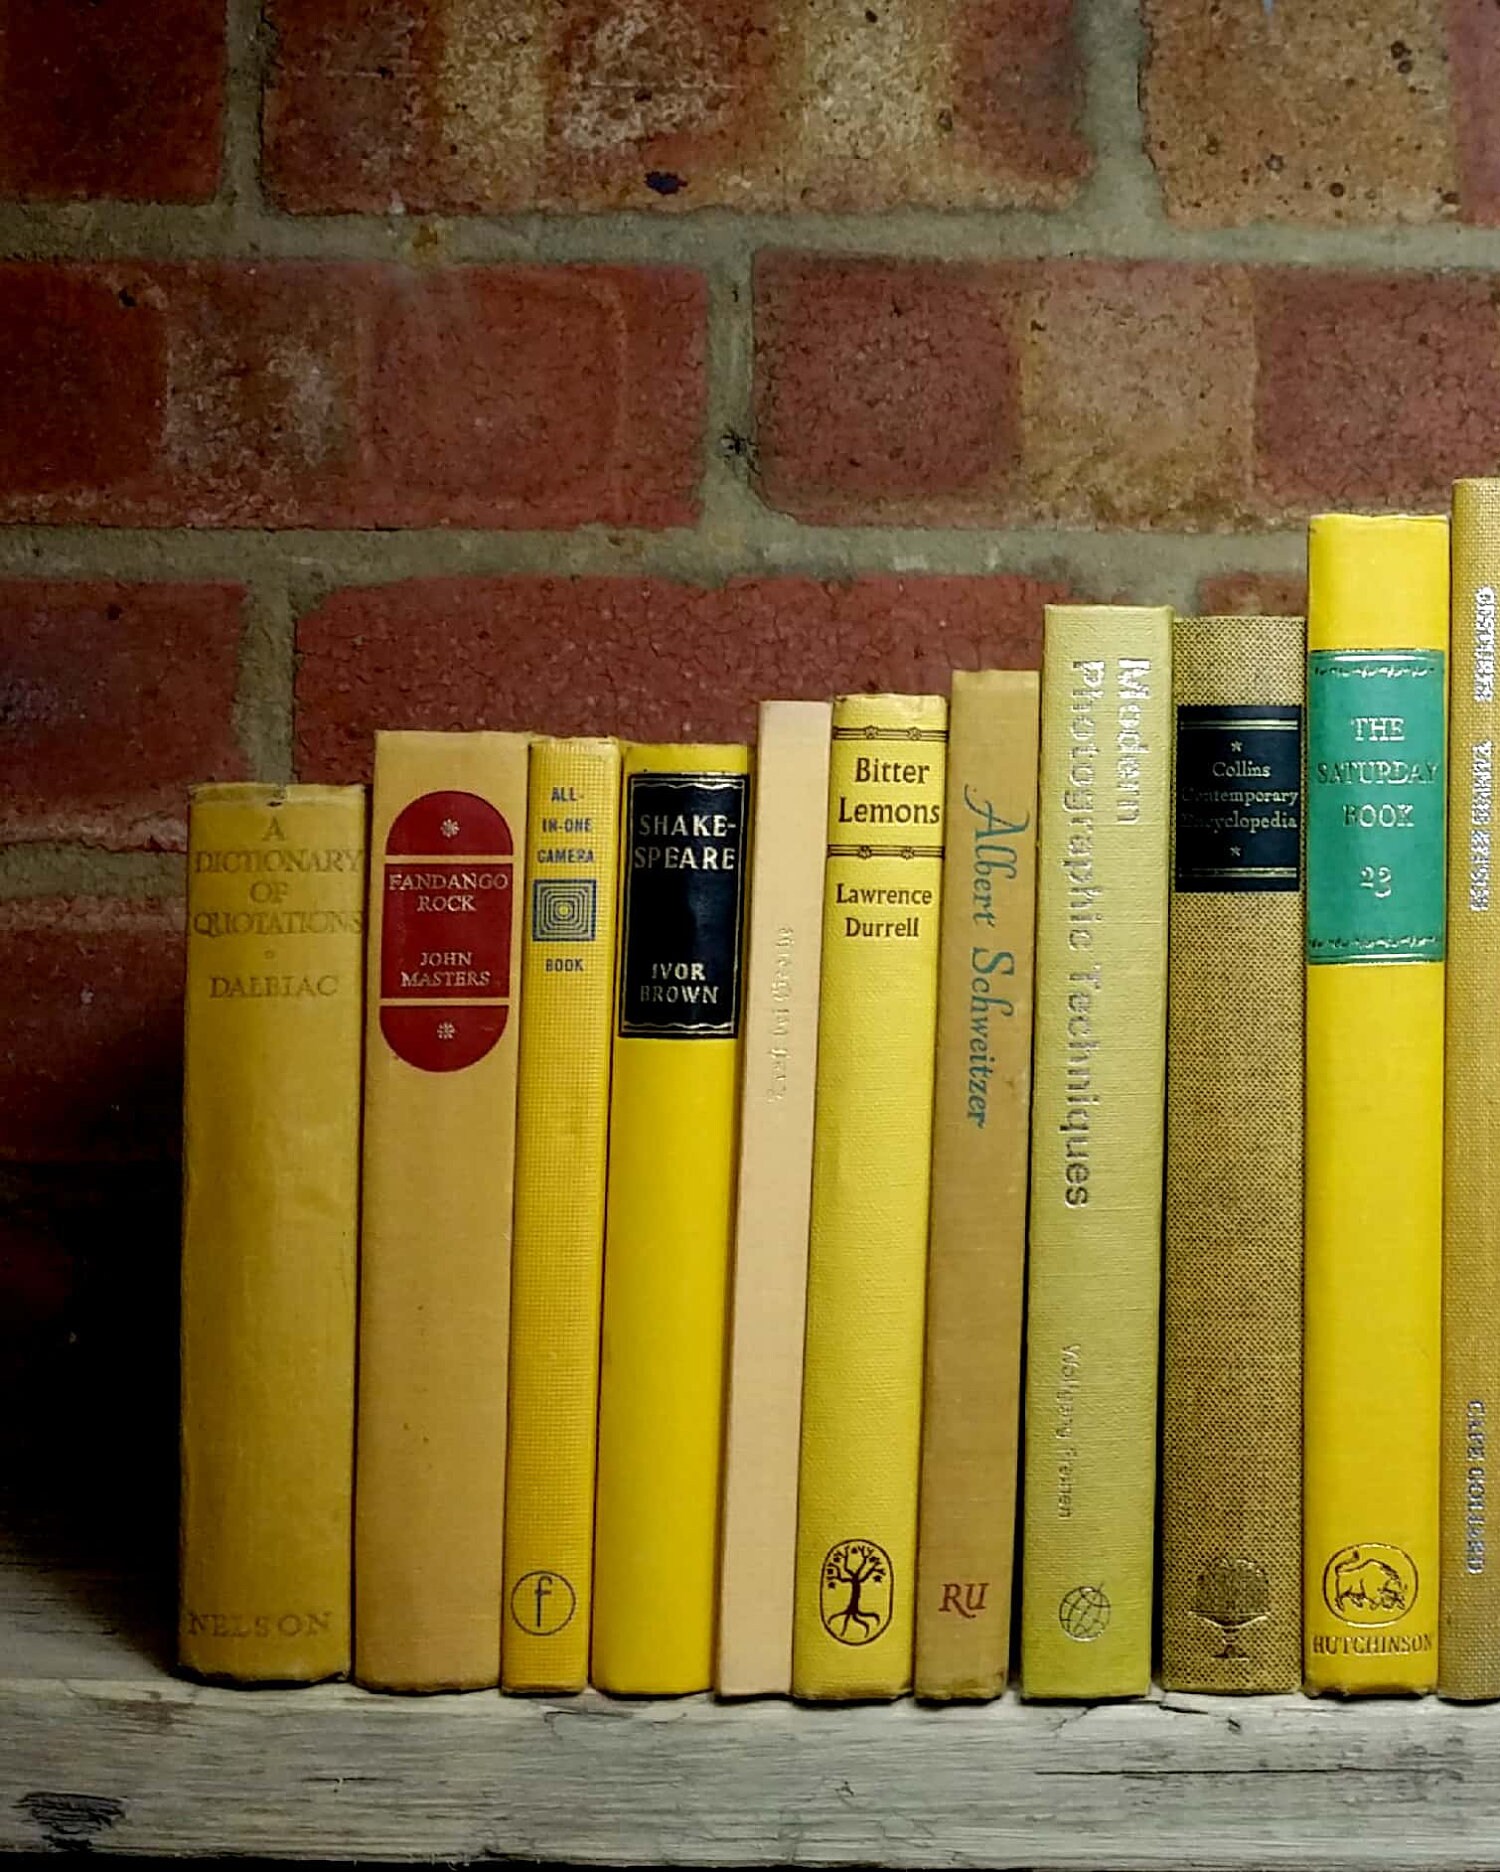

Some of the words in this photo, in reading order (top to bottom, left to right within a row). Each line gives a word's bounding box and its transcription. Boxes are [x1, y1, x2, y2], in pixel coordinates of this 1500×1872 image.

[1116, 657, 1152, 825] Modern
[1351, 717, 1405, 742] THE
[855, 757, 930, 785] Bitter
[1212, 760, 1271, 777] Collins
[1317, 762, 1438, 786] SATURDAY
[551, 787, 585, 803] ALL-
[1061, 659, 1105, 951] Photographic
[839, 797, 941, 825] Lemons
[1342, 804, 1415, 828] BOOK
[265, 817, 285, 839] A
[542, 817, 593, 834] IN-ONE
[639, 813, 736, 838] SHAKE-
[196, 849, 364, 873] DICTIONARY
[537, 848, 596, 864] CAMERA
[634, 847, 735, 870] SPEARE
[963, 785, 1031, 929] Albert
[250, 882, 288, 903] OF
[389, 873, 508, 891] FANDANGO
[418, 894, 475, 912] ROCK
[836, 883, 933, 906] Lawrence
[194, 911, 364, 938] QUOTATIONS
[845, 916, 920, 938] Durrell
[420, 952, 472, 968] JOHN
[545, 957, 585, 973] BOOK
[401, 971, 491, 988] MASTERS
[652, 963, 706, 981] IVOR
[640, 984, 718, 1005] BROWN
[966, 947, 1016, 1130] Schweitzer
[1059, 961, 1102, 1209] Techniques
[189, 1611, 331, 1638] NELSON
[1310, 1633, 1432, 1656] HUTCHINSON
